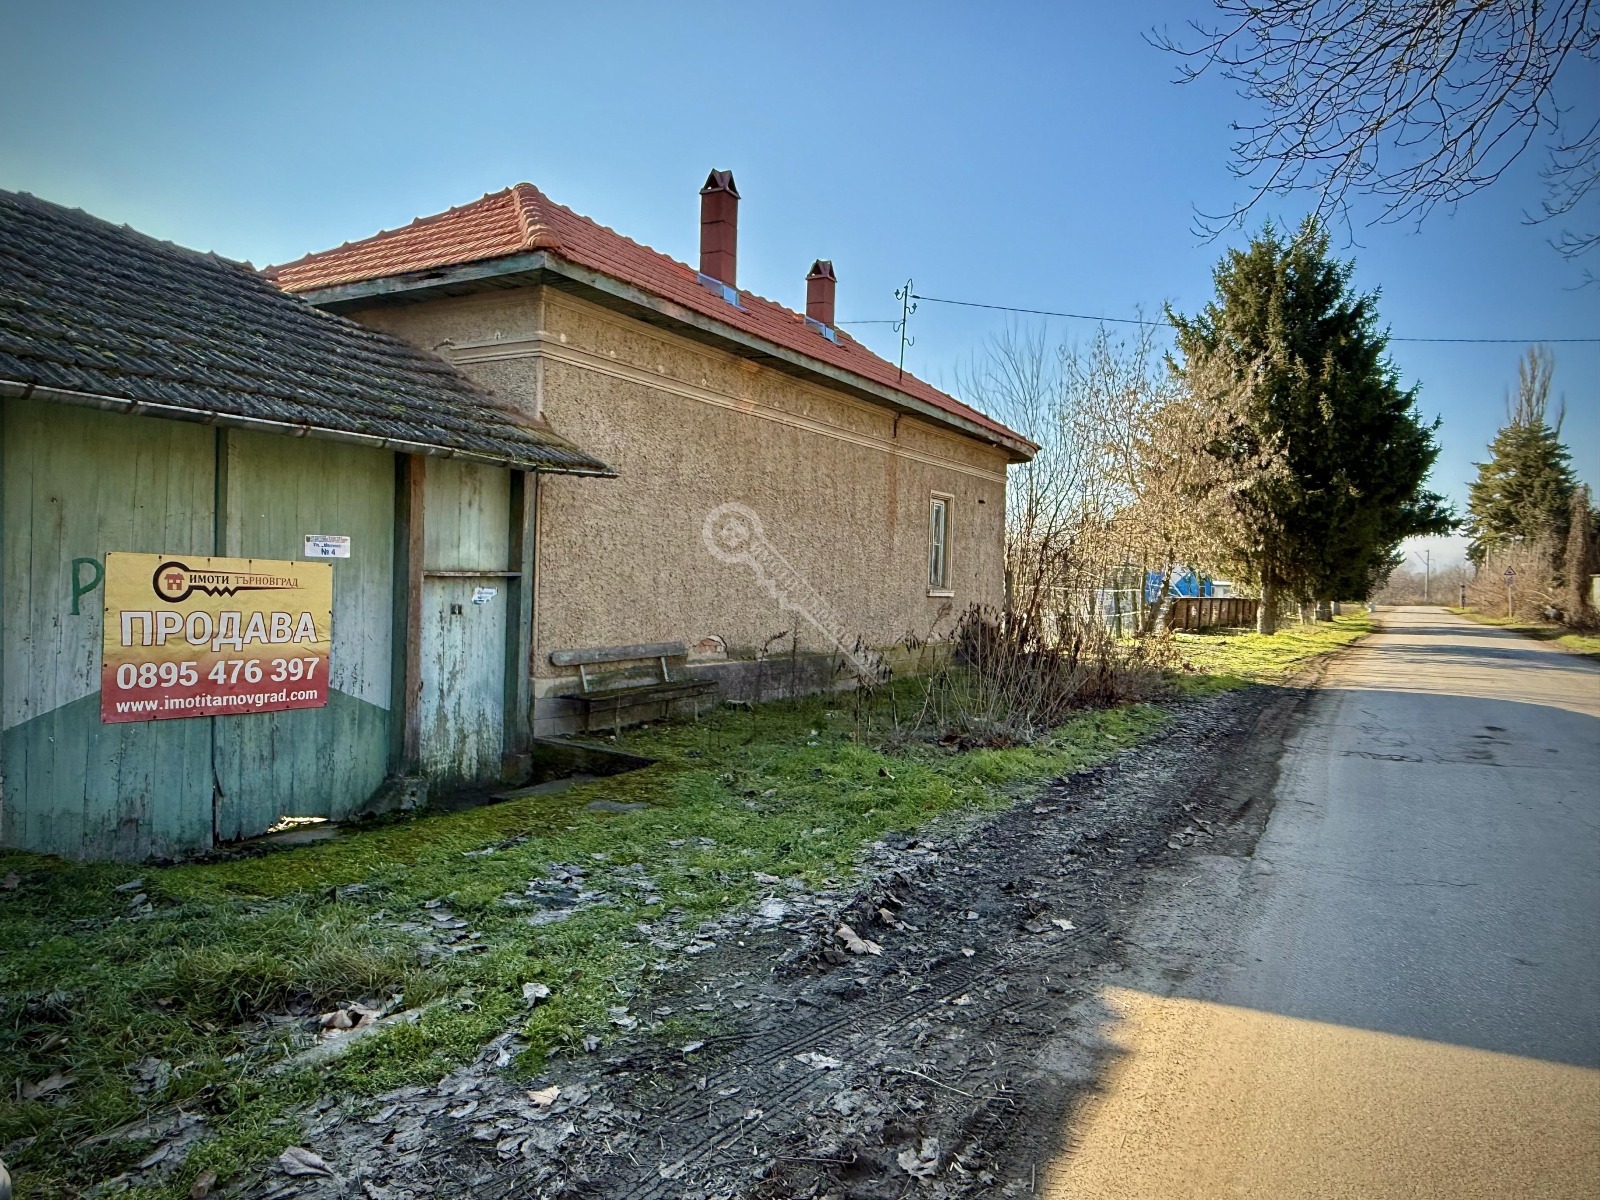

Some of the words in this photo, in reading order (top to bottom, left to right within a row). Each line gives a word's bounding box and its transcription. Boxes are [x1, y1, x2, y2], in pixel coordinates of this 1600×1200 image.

[189, 574, 229, 585] ИМОТИ
[234, 576, 298, 588] ТЪРНОВГРАД
[120, 610, 318, 652] ПРОДАВА
[116, 661, 199, 690] 0895
[208, 659, 263, 685] 476
[270, 657, 320, 682] 397
[116, 688, 318, 713] www.imotitarnovgrad.com
